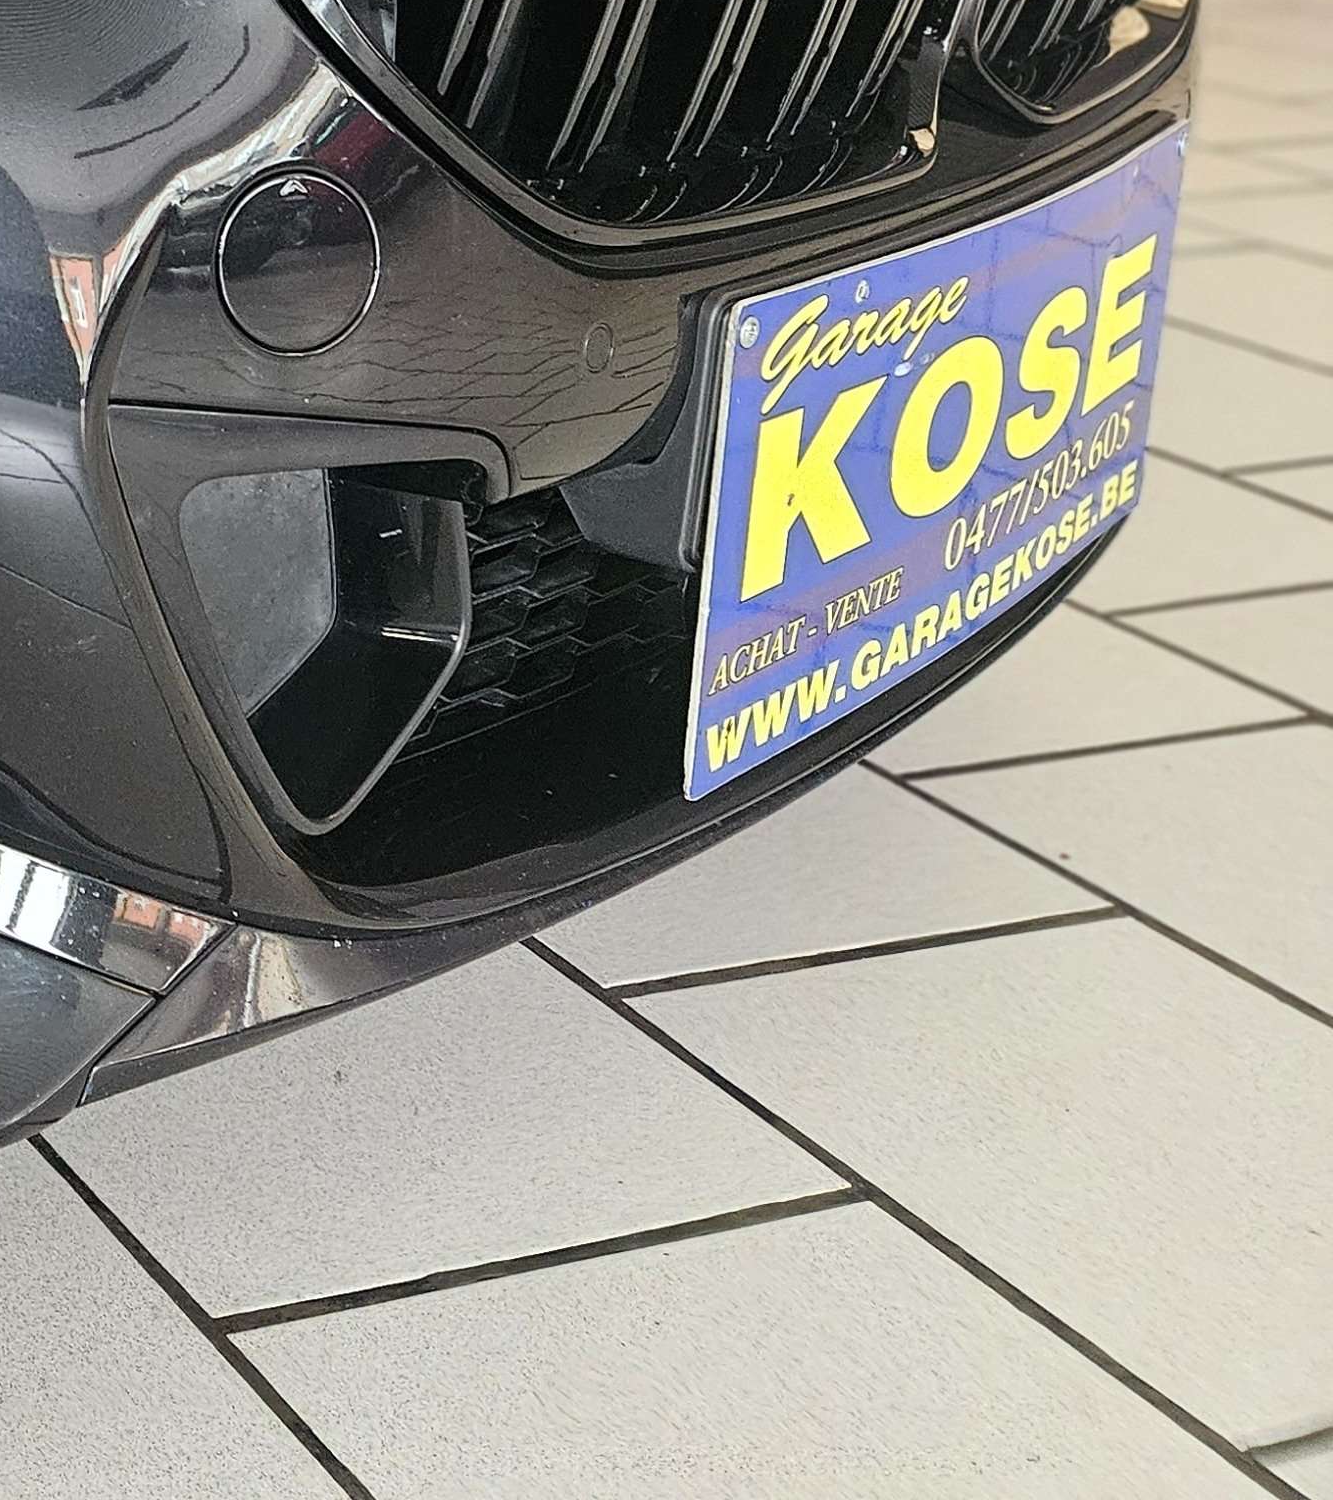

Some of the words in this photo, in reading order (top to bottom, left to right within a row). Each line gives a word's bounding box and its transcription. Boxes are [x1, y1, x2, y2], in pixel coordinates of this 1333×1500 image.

[740, 234, 1157, 603] KOSE
[760, 276, 970, 415] Garage
[944, 401, 1134, 571] 0477/503.605
[705, 461, 1138, 773] WWW.GARAGEKOSE.BE
[708, 613, 807, 695] ACHAT
[824, 566, 904, 635] VENTE
